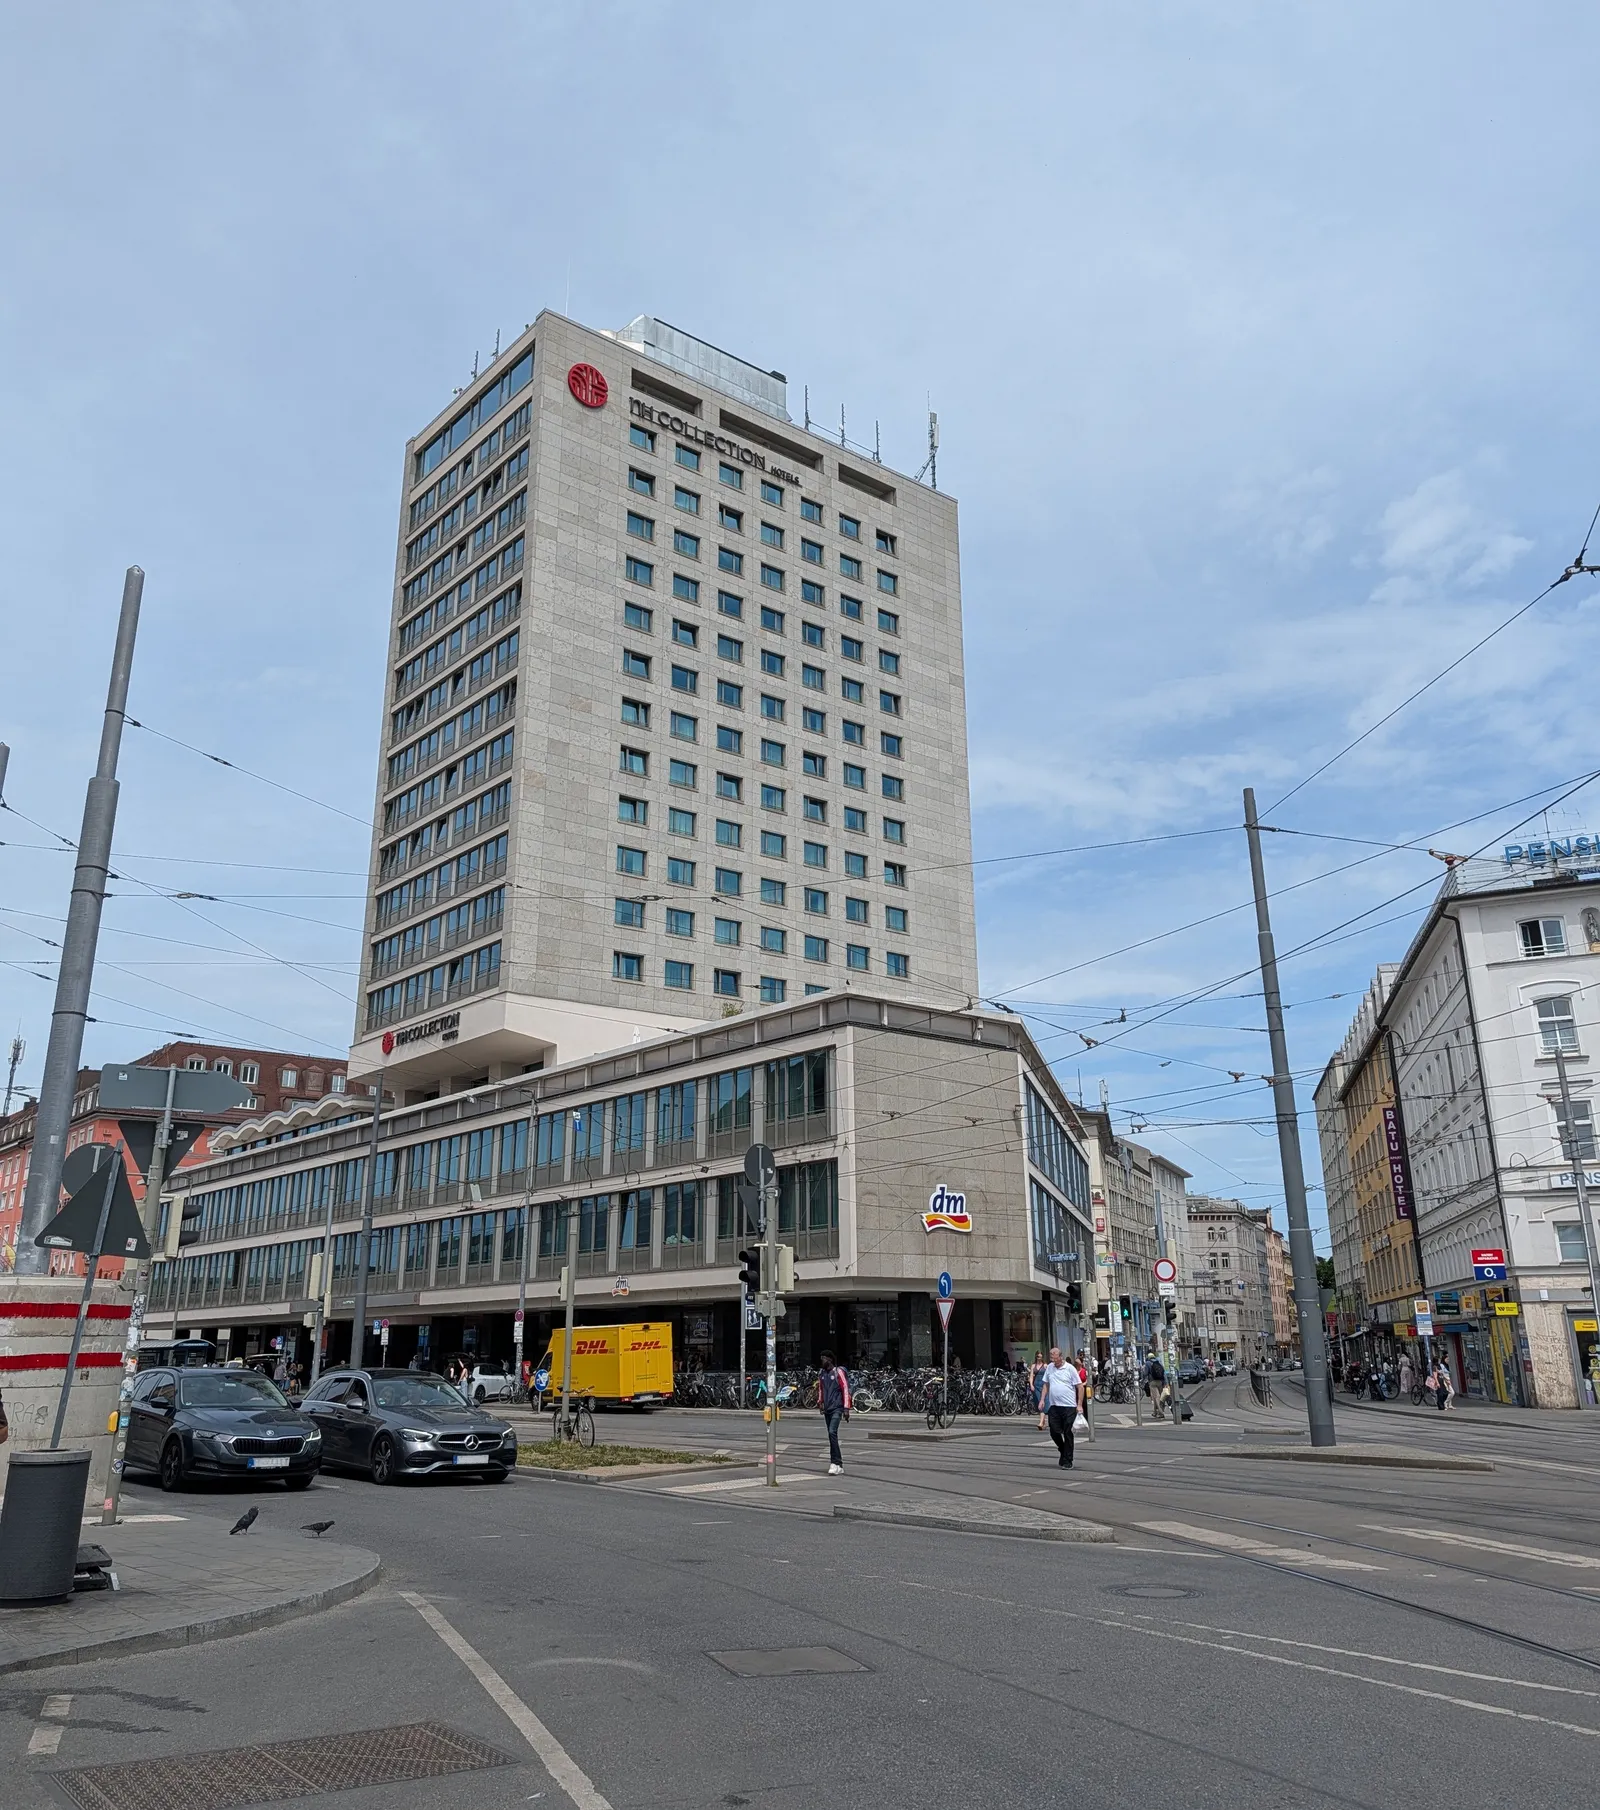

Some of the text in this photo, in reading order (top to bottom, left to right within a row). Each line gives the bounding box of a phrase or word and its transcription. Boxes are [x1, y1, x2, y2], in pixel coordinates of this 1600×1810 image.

[657, 411, 766, 470] COLLECTION
[770, 465, 800, 485] HOTELS
[409, 1012, 461, 1041] COLLECTION
[1385, 1110, 1399, 1151] BATU
[932, 1186, 965, 1214] dm
[1393, 1164, 1407, 1216] HOTEL
[615, 1276, 627, 1288] dm
[575, 1340, 609, 1355] DHL
[630, 1341, 662, 1351] DHL
